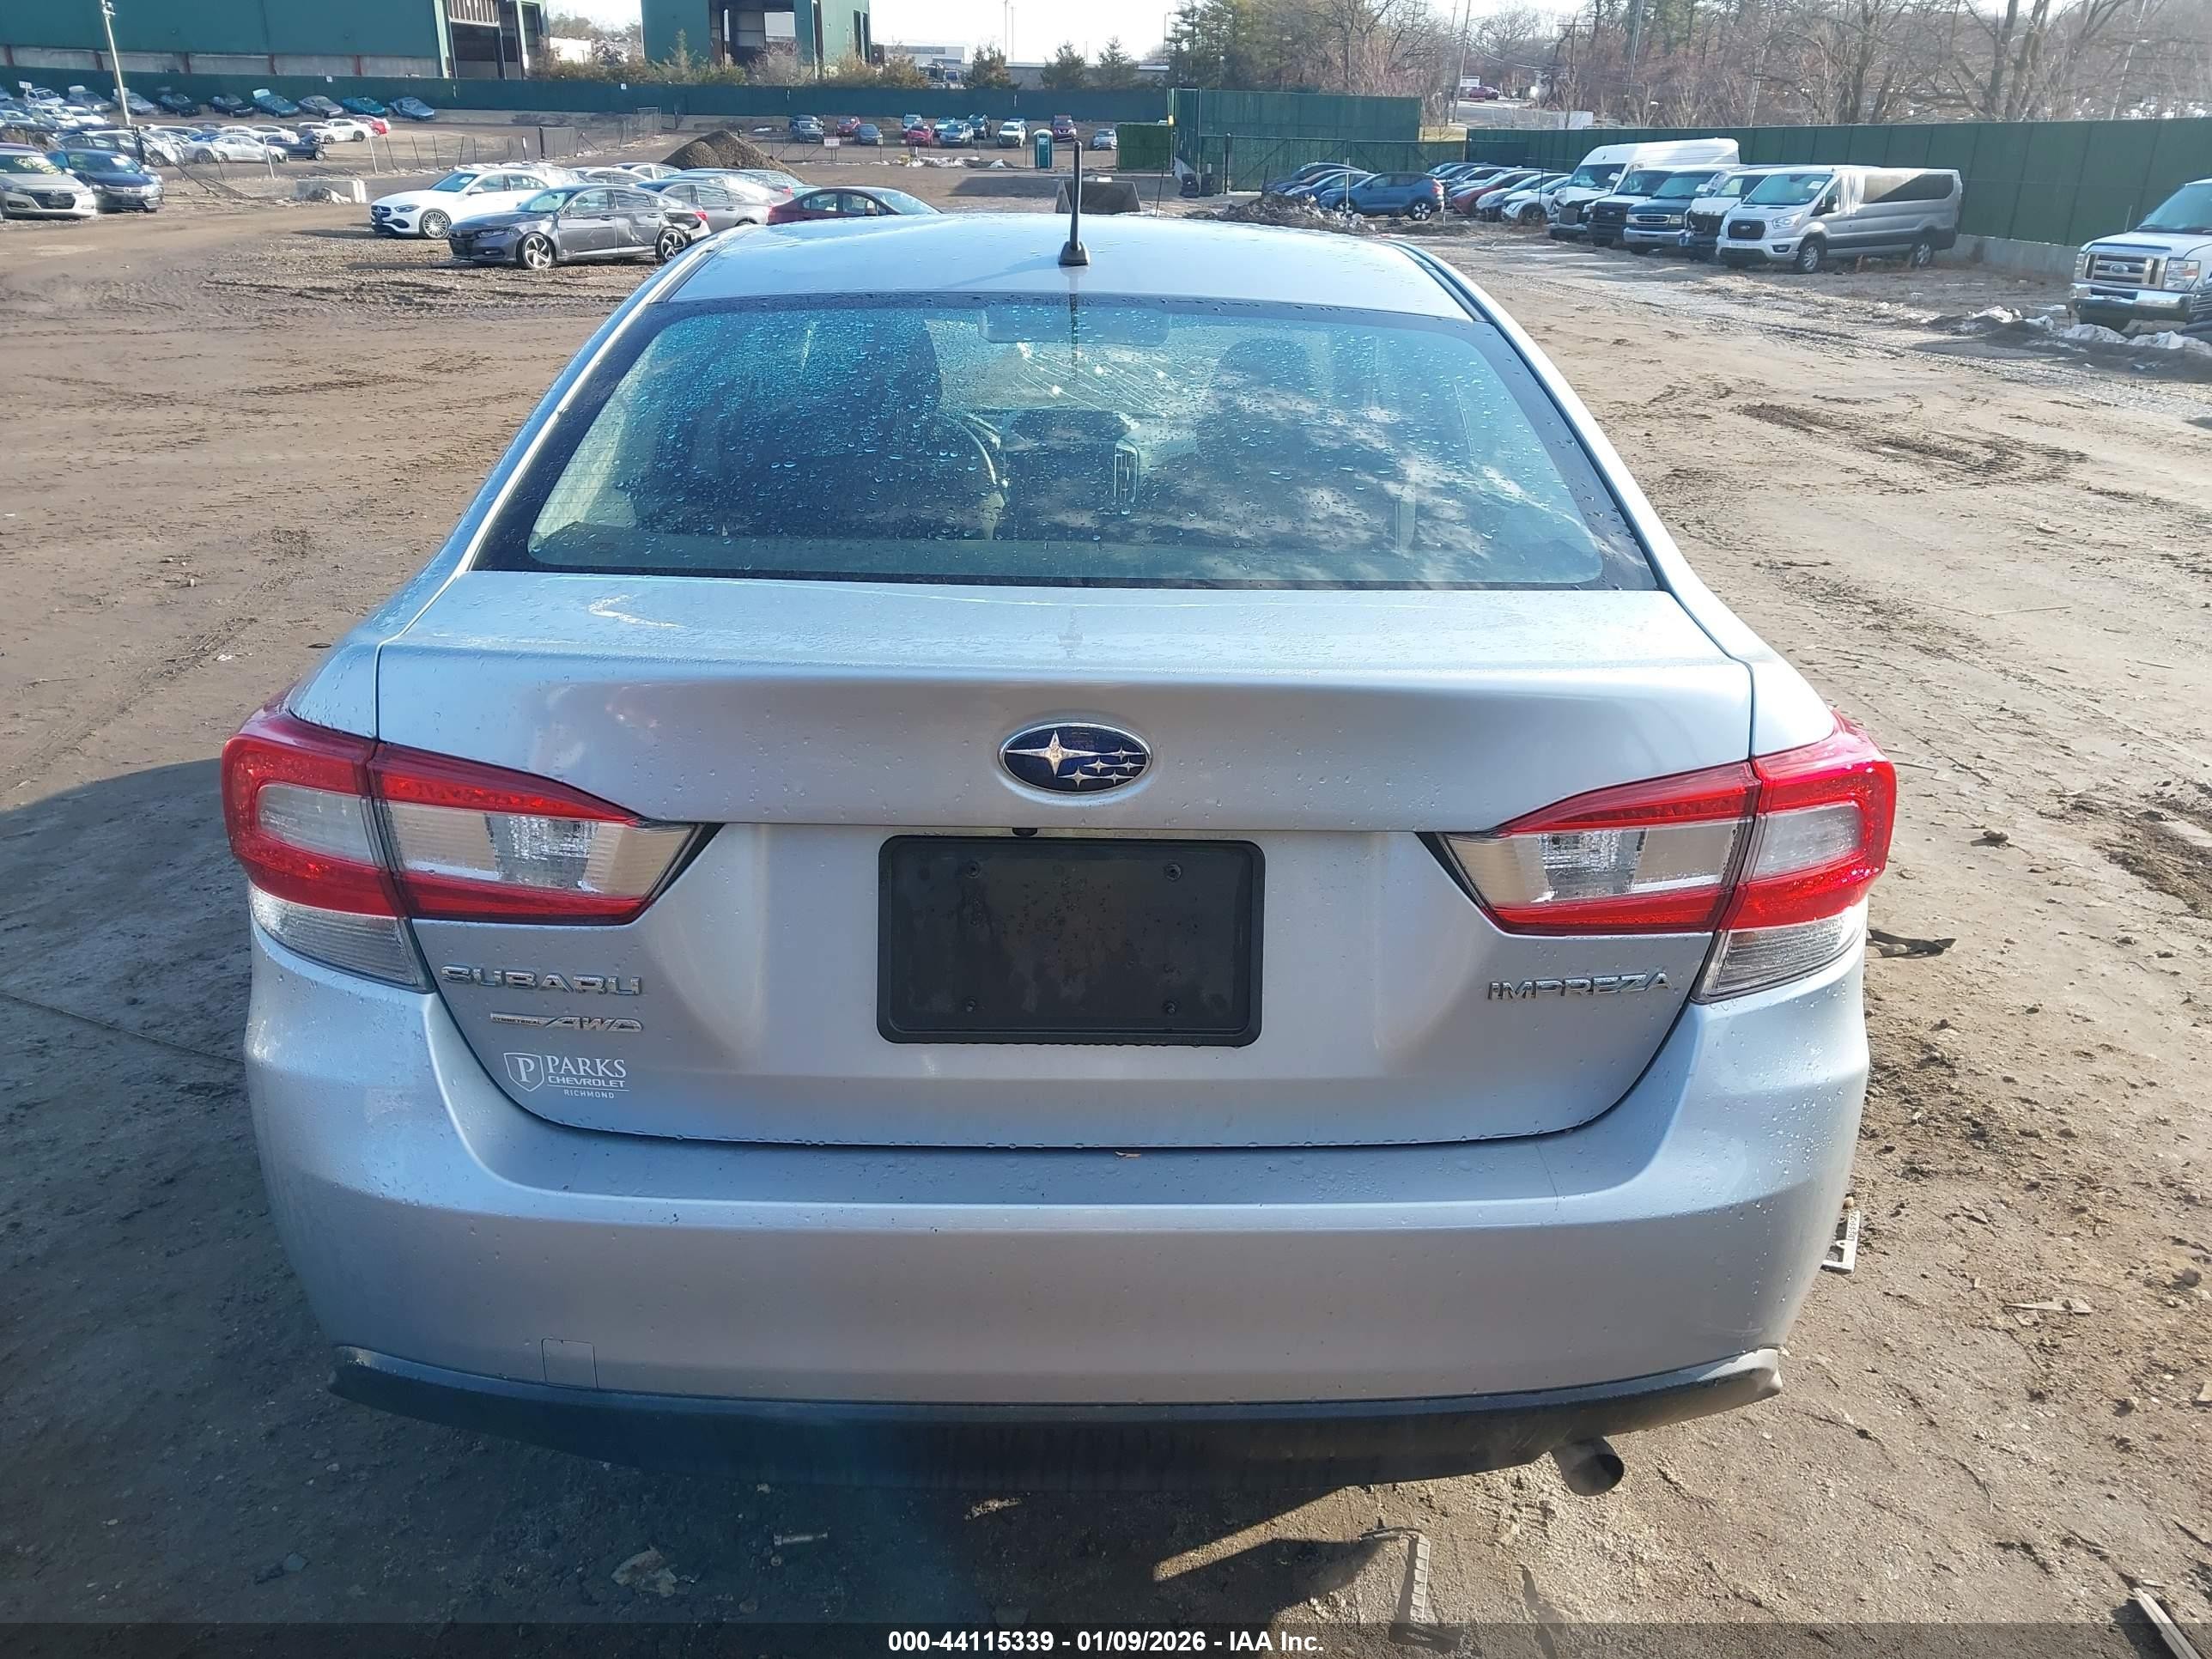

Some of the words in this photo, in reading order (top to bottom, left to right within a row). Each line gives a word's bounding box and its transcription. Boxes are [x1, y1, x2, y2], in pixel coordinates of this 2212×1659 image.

[441, 964, 642, 996] SUBARU
[1487, 971, 1673, 1000] IMPREZA
[545, 1015, 644, 1032] AWD
[514, 1056, 536, 1084] P
[544, 1054, 627, 1079] PARKS
[548, 1075, 625, 1088] CHEVROLET
[563, 1089, 615, 1099] RICHMOND
